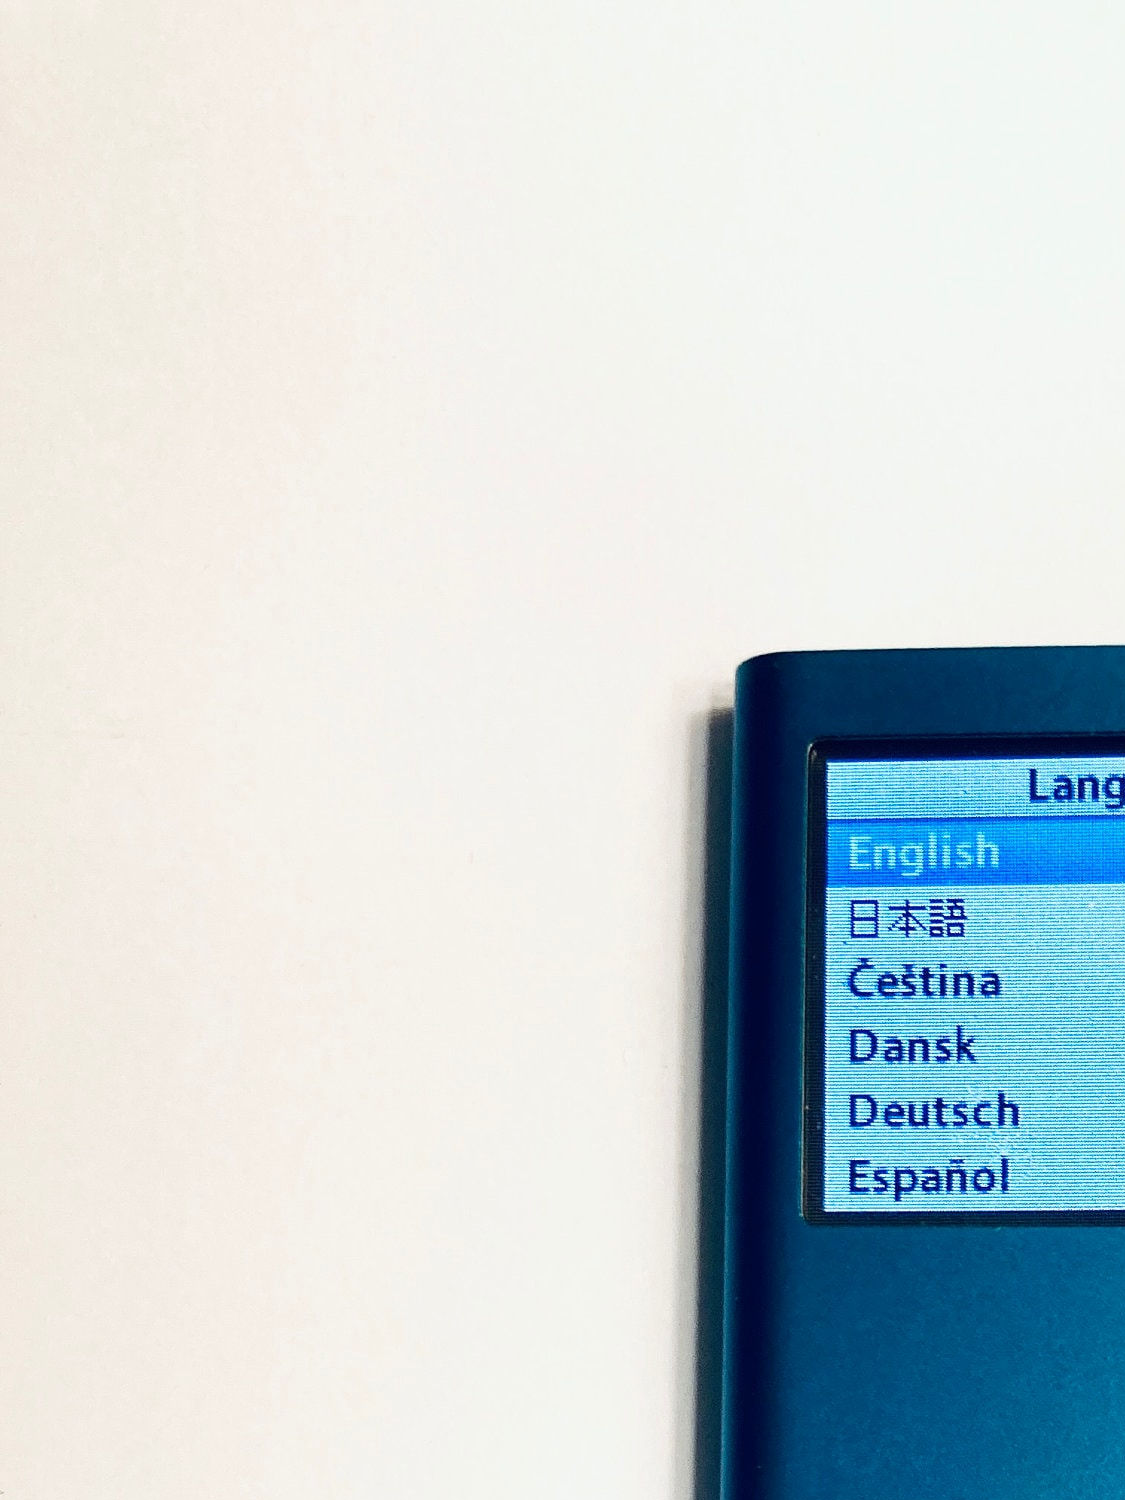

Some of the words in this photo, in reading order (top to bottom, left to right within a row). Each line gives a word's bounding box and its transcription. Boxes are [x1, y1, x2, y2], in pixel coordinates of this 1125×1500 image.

[847, 831, 1001, 876] English
[849, 898, 968, 938] 日本語
[848, 957, 1001, 998] Čeština
[848, 1025, 976, 1063] Dansk
[848, 1092, 1021, 1128] Deutsch
[848, 1155, 1011, 1201] Español
